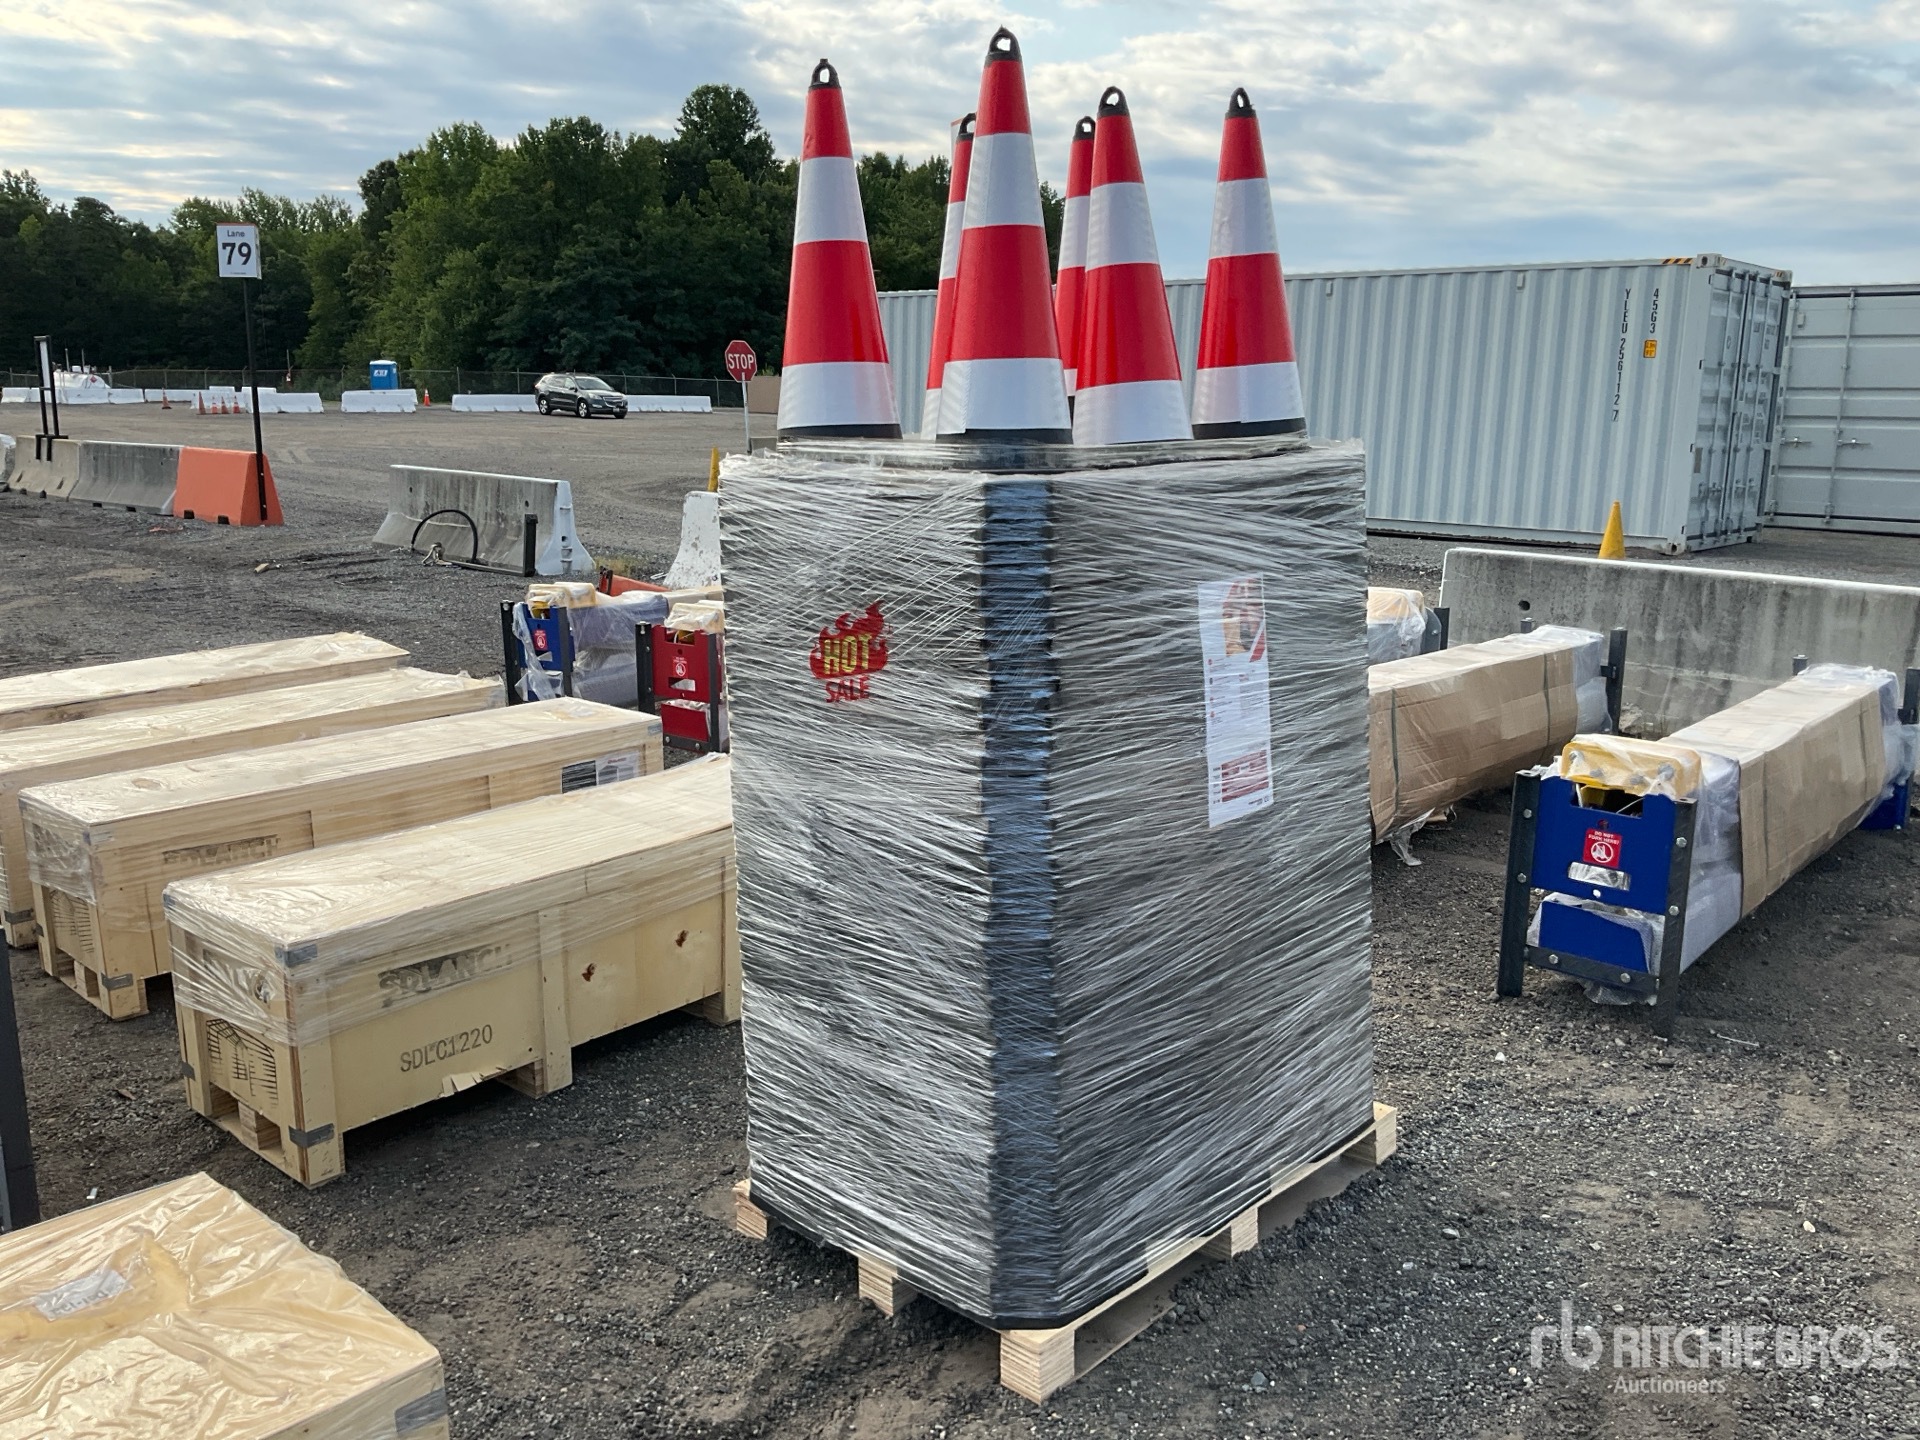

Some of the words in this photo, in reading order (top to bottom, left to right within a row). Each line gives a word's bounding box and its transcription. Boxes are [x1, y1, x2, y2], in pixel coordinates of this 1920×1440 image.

[222, 242, 252, 265] 79
[1649, 288, 1659, 333] 45G3
[728, 353, 754, 369] STOP
[1612, 410, 1619, 421] 7
[824, 633, 872, 675] HOT
[825, 676, 870, 703] SALE
